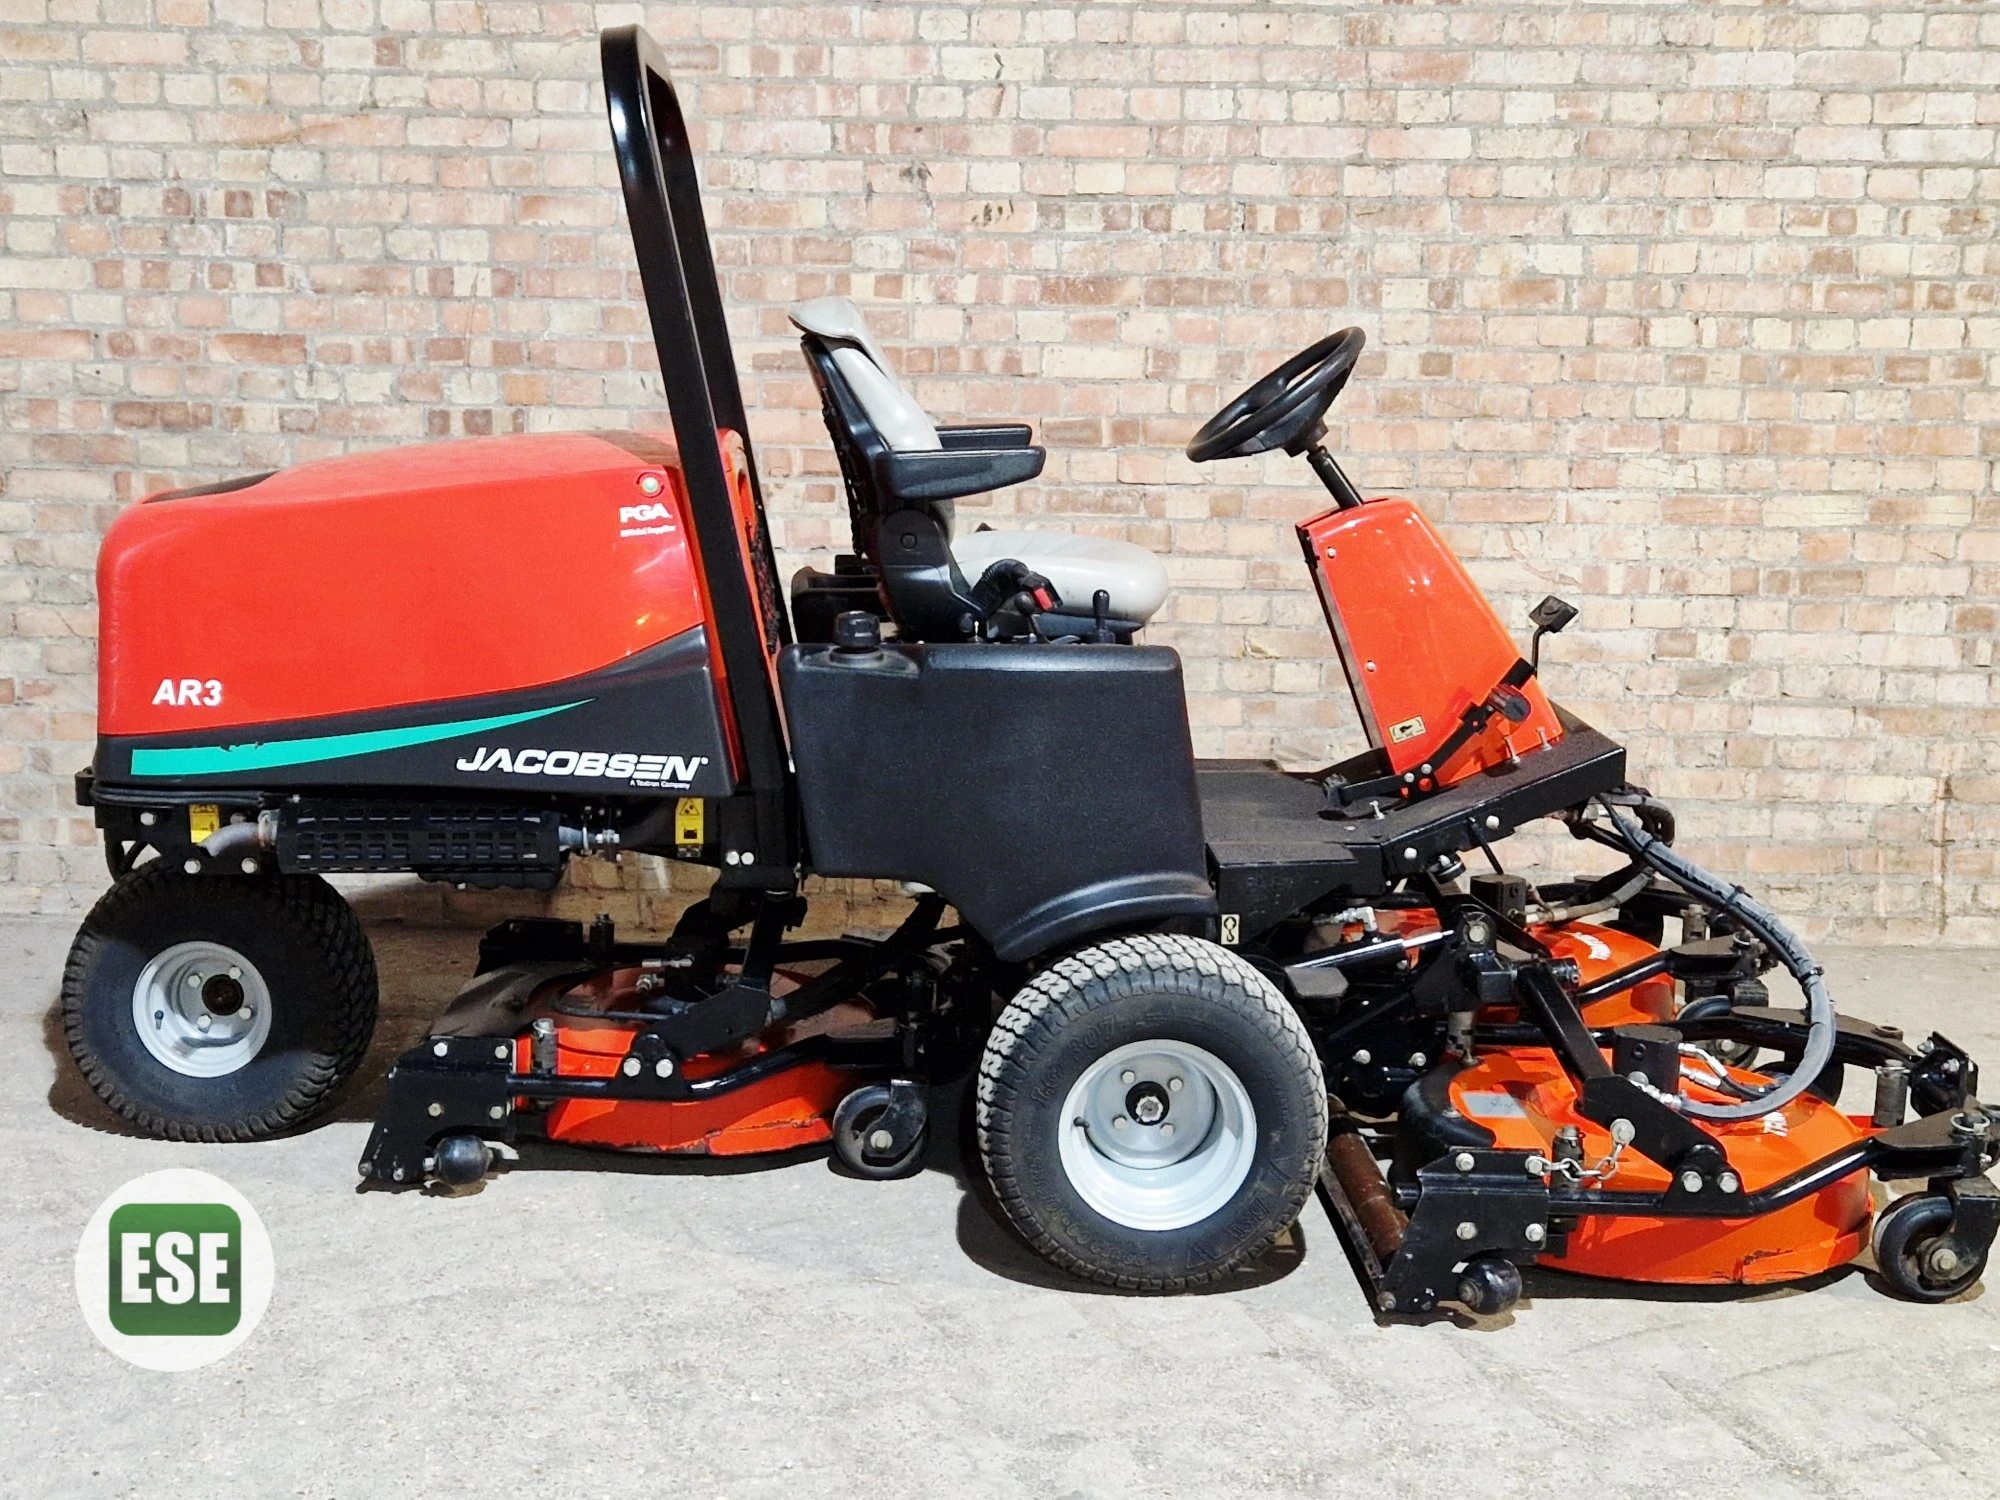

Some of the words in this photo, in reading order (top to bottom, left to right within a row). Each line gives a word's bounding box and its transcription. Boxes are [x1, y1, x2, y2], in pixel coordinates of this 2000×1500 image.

[619, 502, 673, 523] PGA
[151, 678, 223, 707] AR3
[455, 747, 702, 781] JACOBSEN
